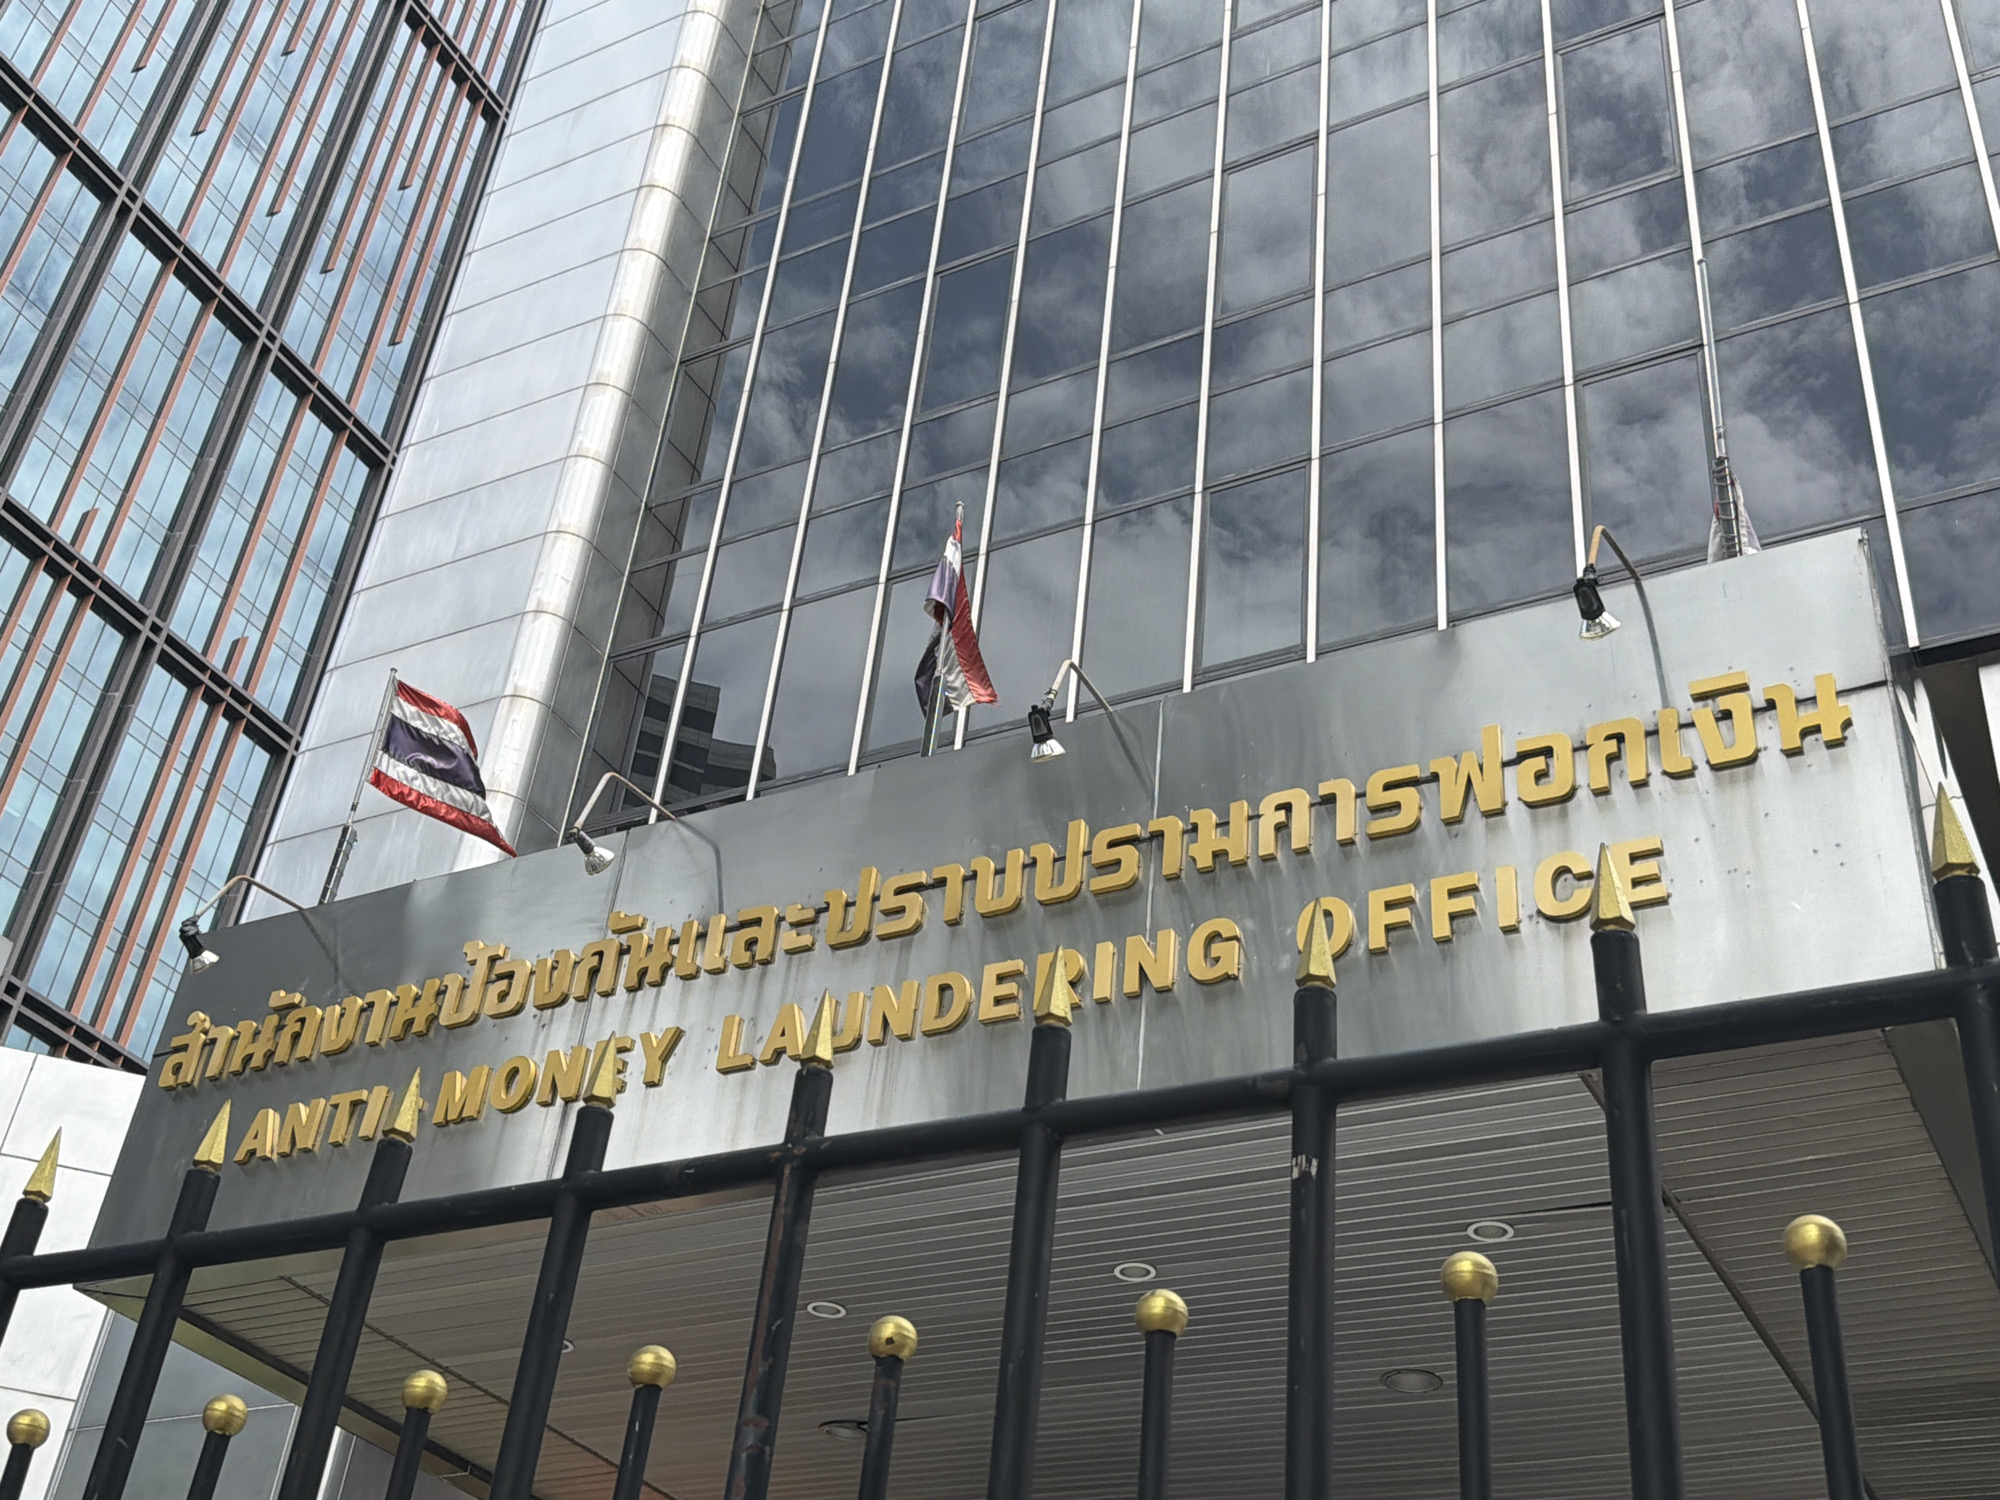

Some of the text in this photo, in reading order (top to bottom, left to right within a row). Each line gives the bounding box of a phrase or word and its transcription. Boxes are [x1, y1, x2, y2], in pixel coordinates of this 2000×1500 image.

[158, 671, 1851, 1090] สำนักงานป้องกันและปราบปรามการฟอกเงิน
[716, 917, 1242, 1075] LAUNDERING
[1297, 836, 1671, 959] OFFICE
